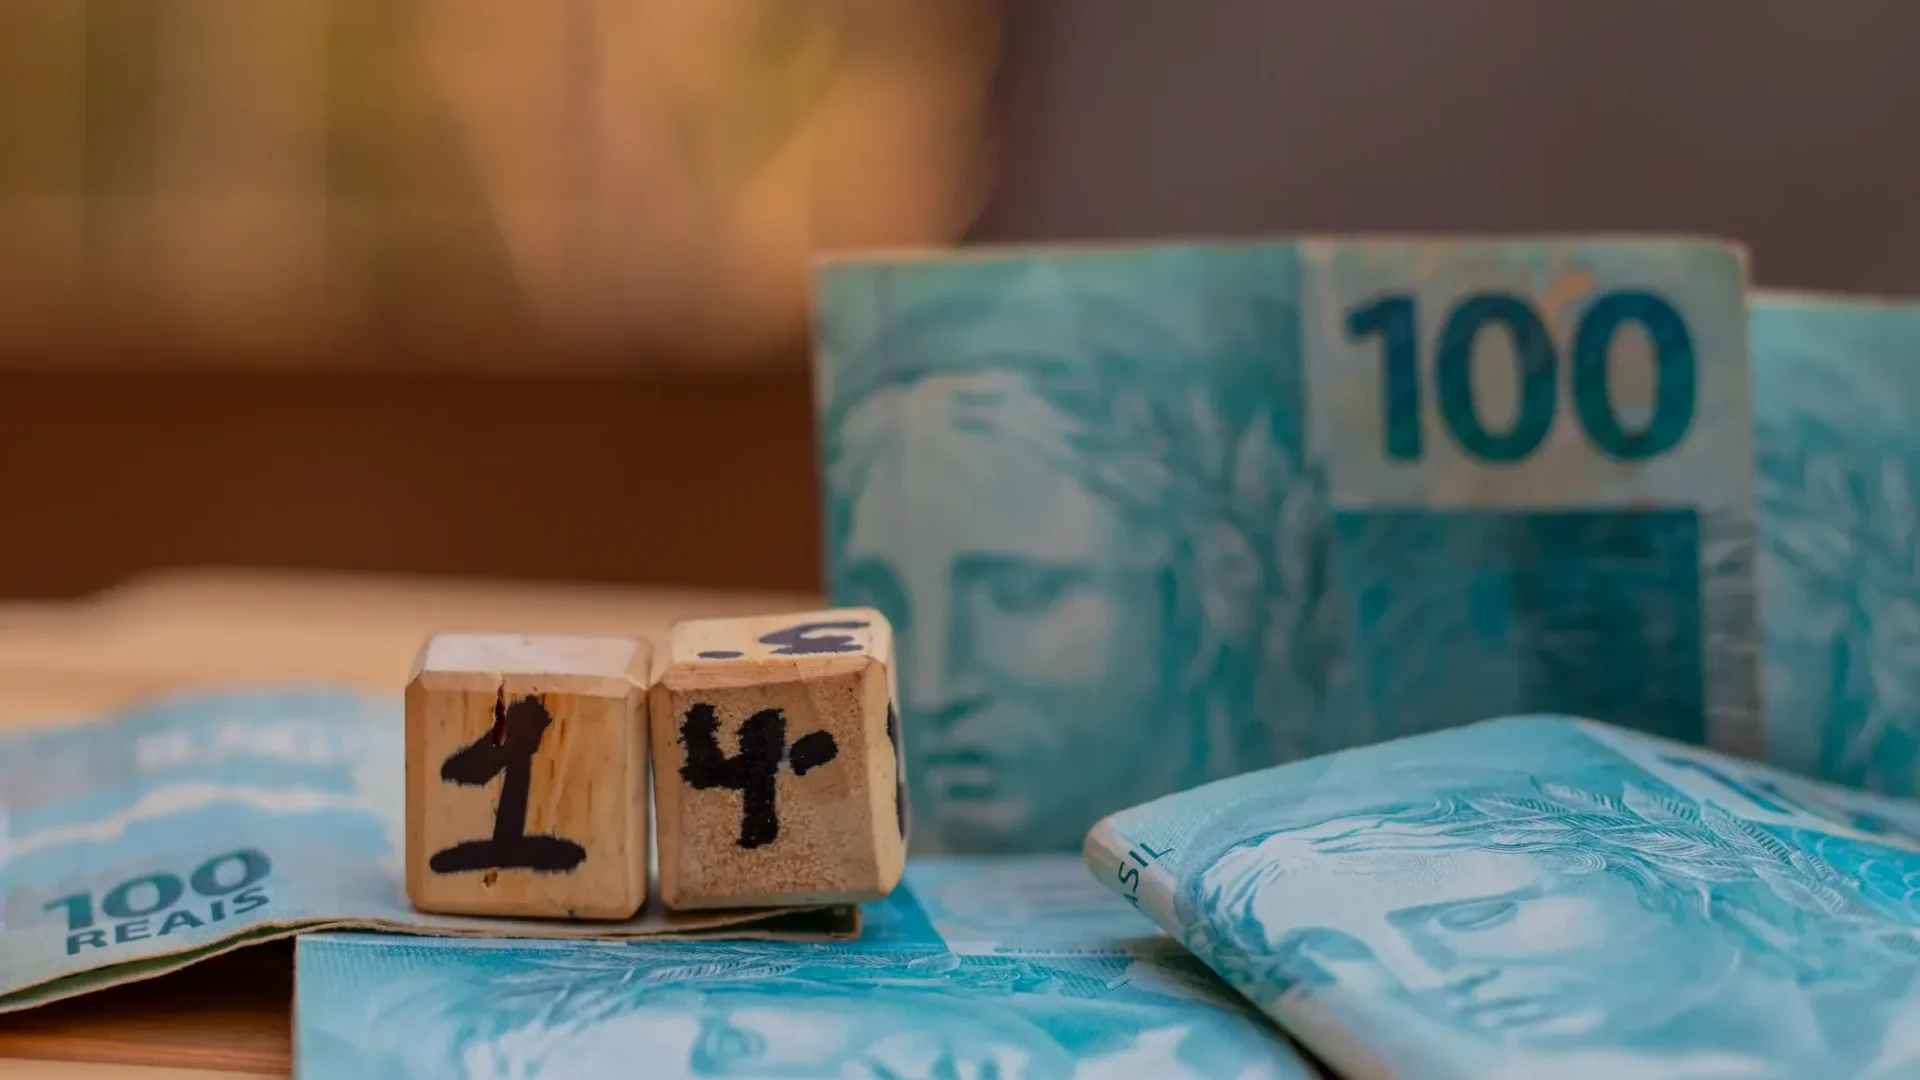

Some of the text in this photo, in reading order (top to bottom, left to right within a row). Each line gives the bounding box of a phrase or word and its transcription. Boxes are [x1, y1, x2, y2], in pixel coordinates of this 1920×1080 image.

[1345, 288, 1697, 464] 100
[42, 848, 273, 932] 100
[66, 886, 271, 955] REAIS
